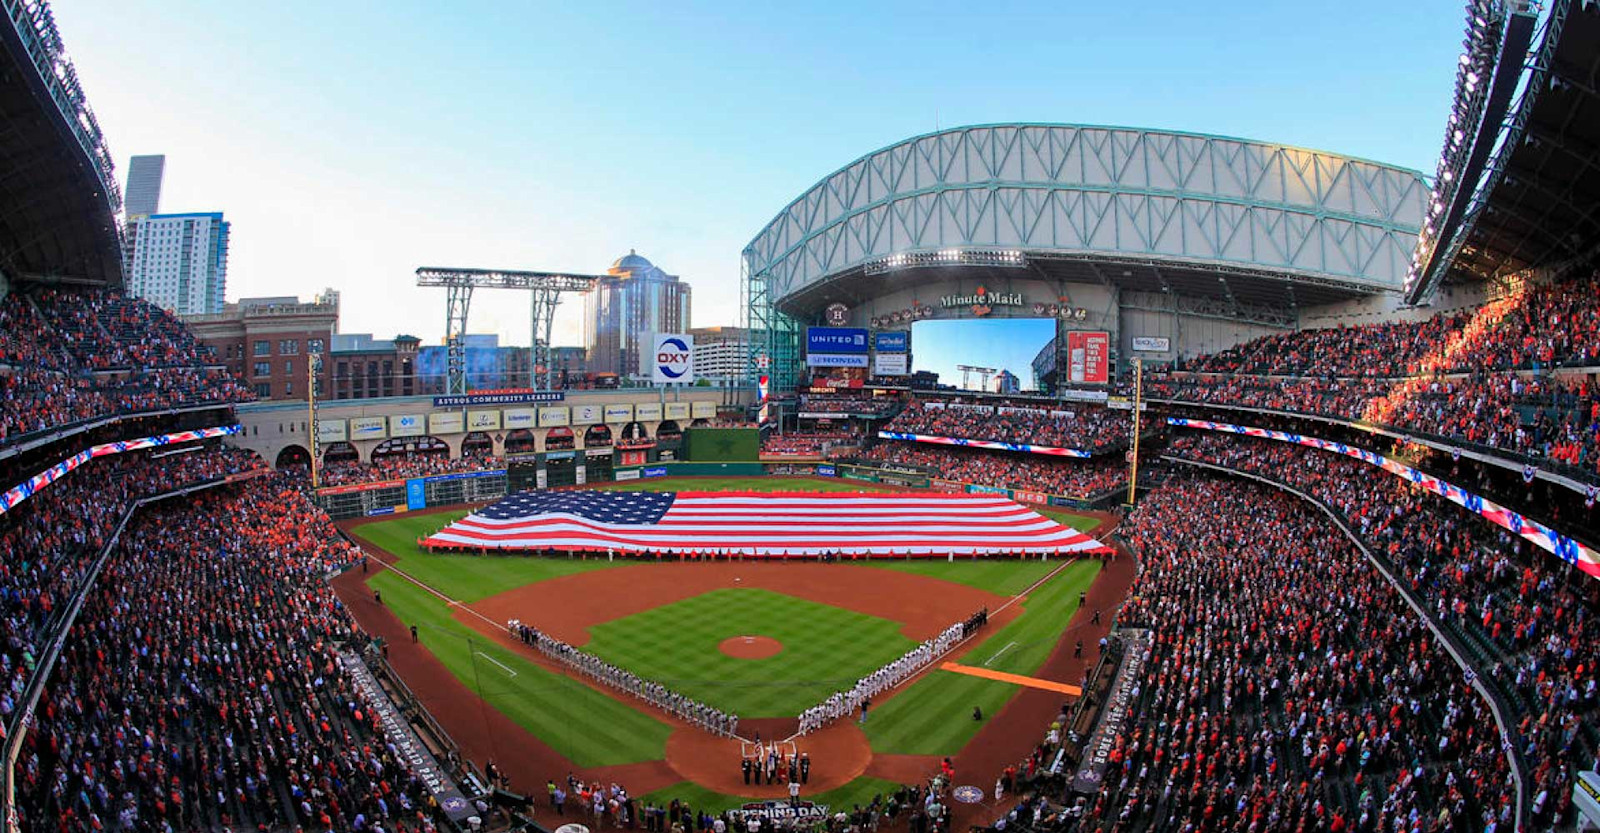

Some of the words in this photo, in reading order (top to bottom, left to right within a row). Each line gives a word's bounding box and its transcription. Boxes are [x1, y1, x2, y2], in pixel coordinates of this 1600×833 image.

[940, 294, 986, 307] Minute
[988, 292, 1022, 306] Maid
[811, 335, 852, 343] UNITED
[658, 353, 689, 363] OXY
[438, 396, 470, 405] ASTROS
[472, 394, 524, 403] COMMUNITY
[526, 393, 561, 401] LEADERS
[351, 667, 375, 696] WELCOME
[379, 709, 405, 740] MINUTE
[401, 740, 423, 765] MAID
[419, 767, 443, 794] PARK
[1094, 738, 1113, 764] HOME
[727, 808, 796, 819] OPENING
[798, 805, 828, 816] DAY
